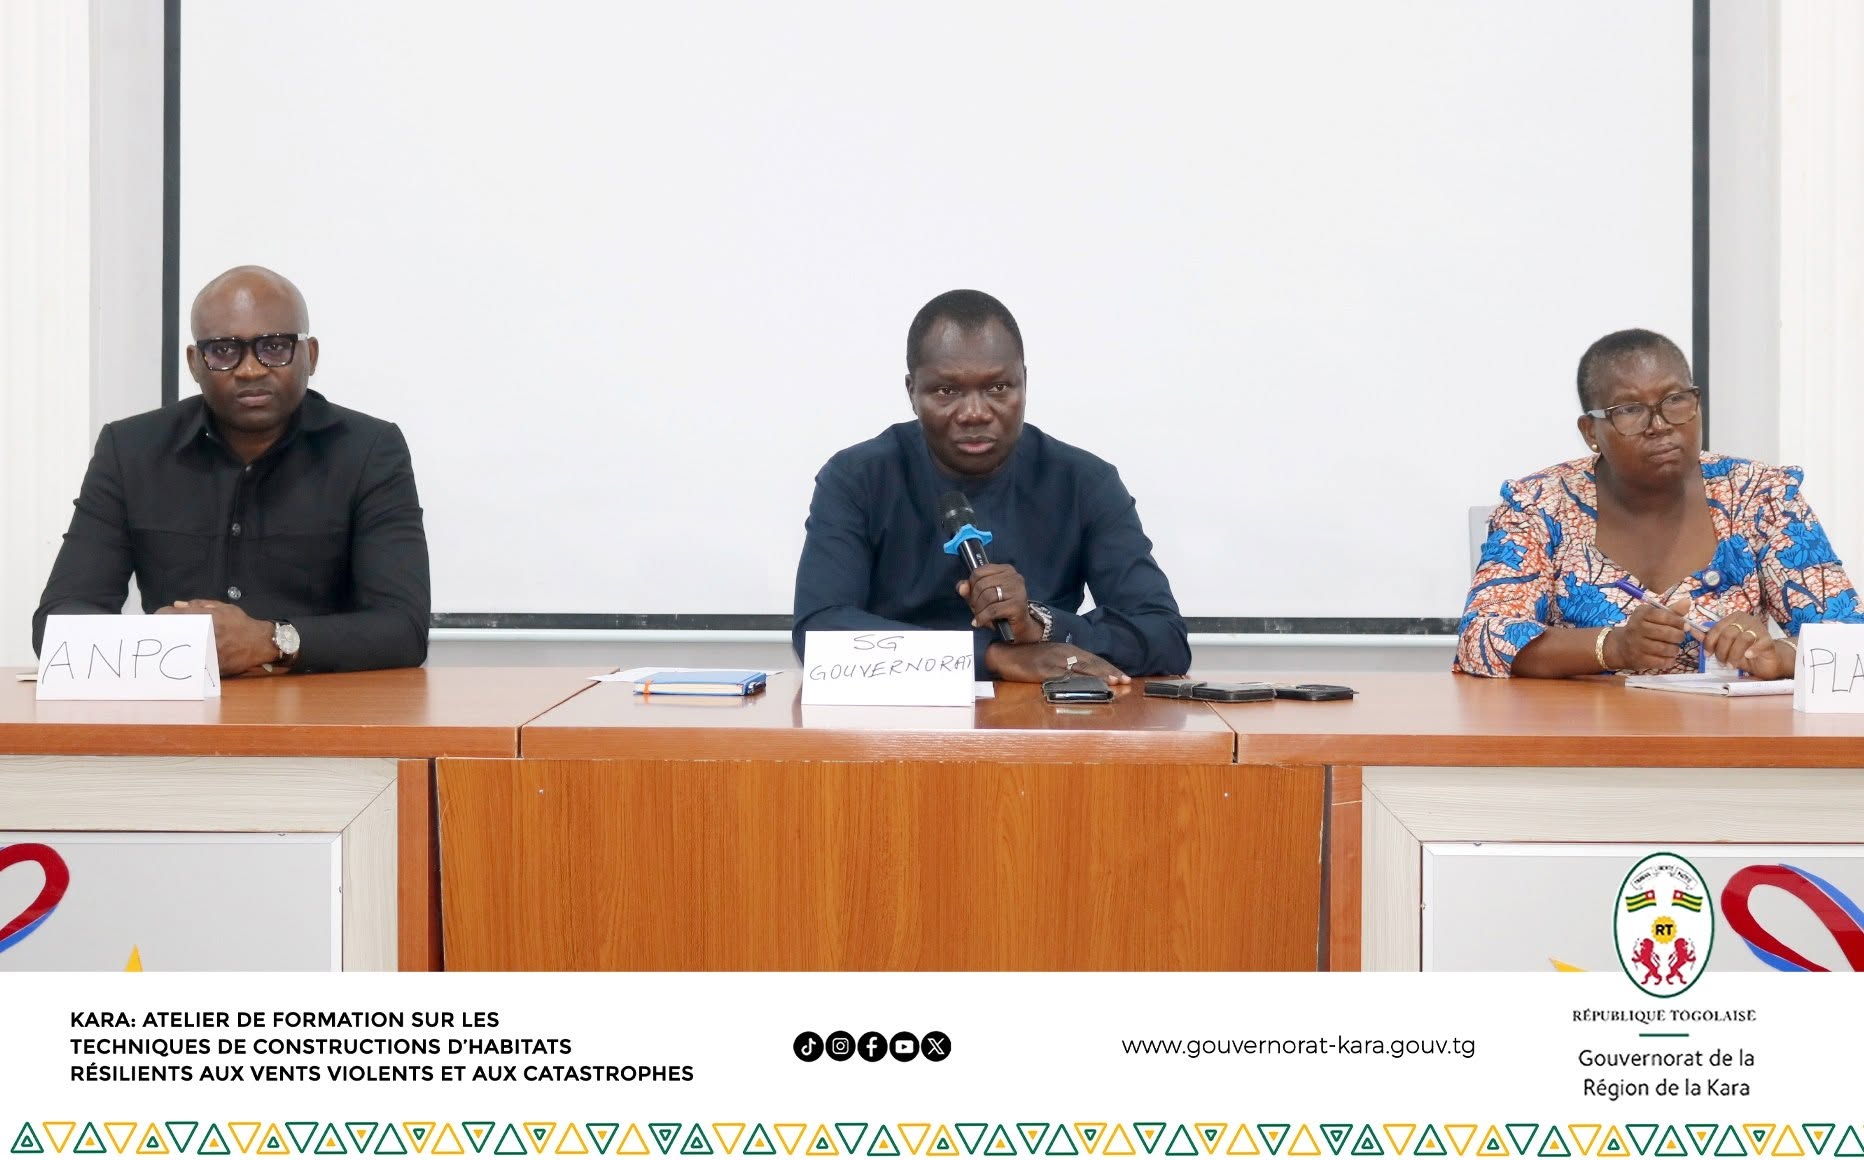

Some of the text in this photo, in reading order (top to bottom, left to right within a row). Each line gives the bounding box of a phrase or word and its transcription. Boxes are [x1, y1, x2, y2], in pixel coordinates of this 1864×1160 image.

[853, 634, 905, 652] SG
[41, 638, 192, 684] ANPC
[809, 654, 973, 681] GOUVERNORAT
